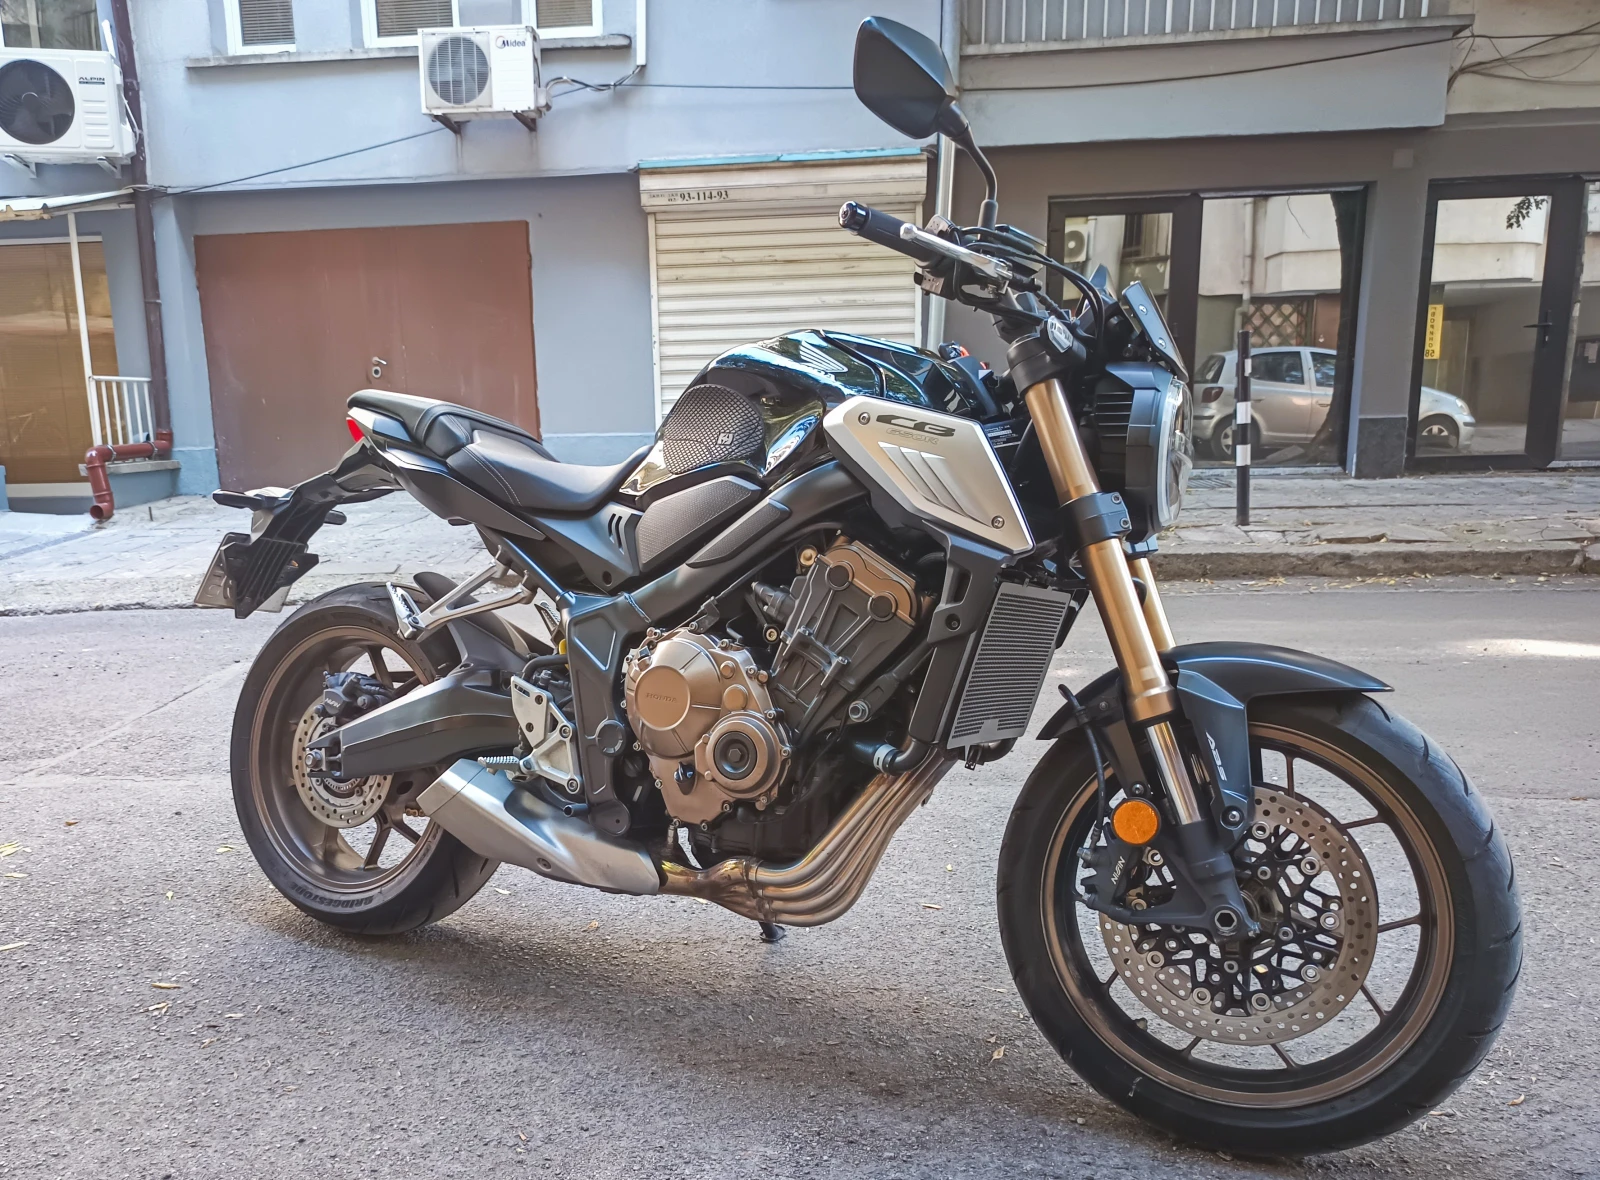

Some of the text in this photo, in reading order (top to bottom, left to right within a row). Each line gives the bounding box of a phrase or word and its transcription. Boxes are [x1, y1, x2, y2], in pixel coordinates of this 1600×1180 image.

[499, 38, 526, 48] Midea
[680, 190, 729, 202] 93-114-93
[876, 414, 956, 437] CB
[645, 692, 679, 704] HONDA
[1205, 731, 1228, 781] ABS
[289, 881, 375, 909] BRIDGESTONE
